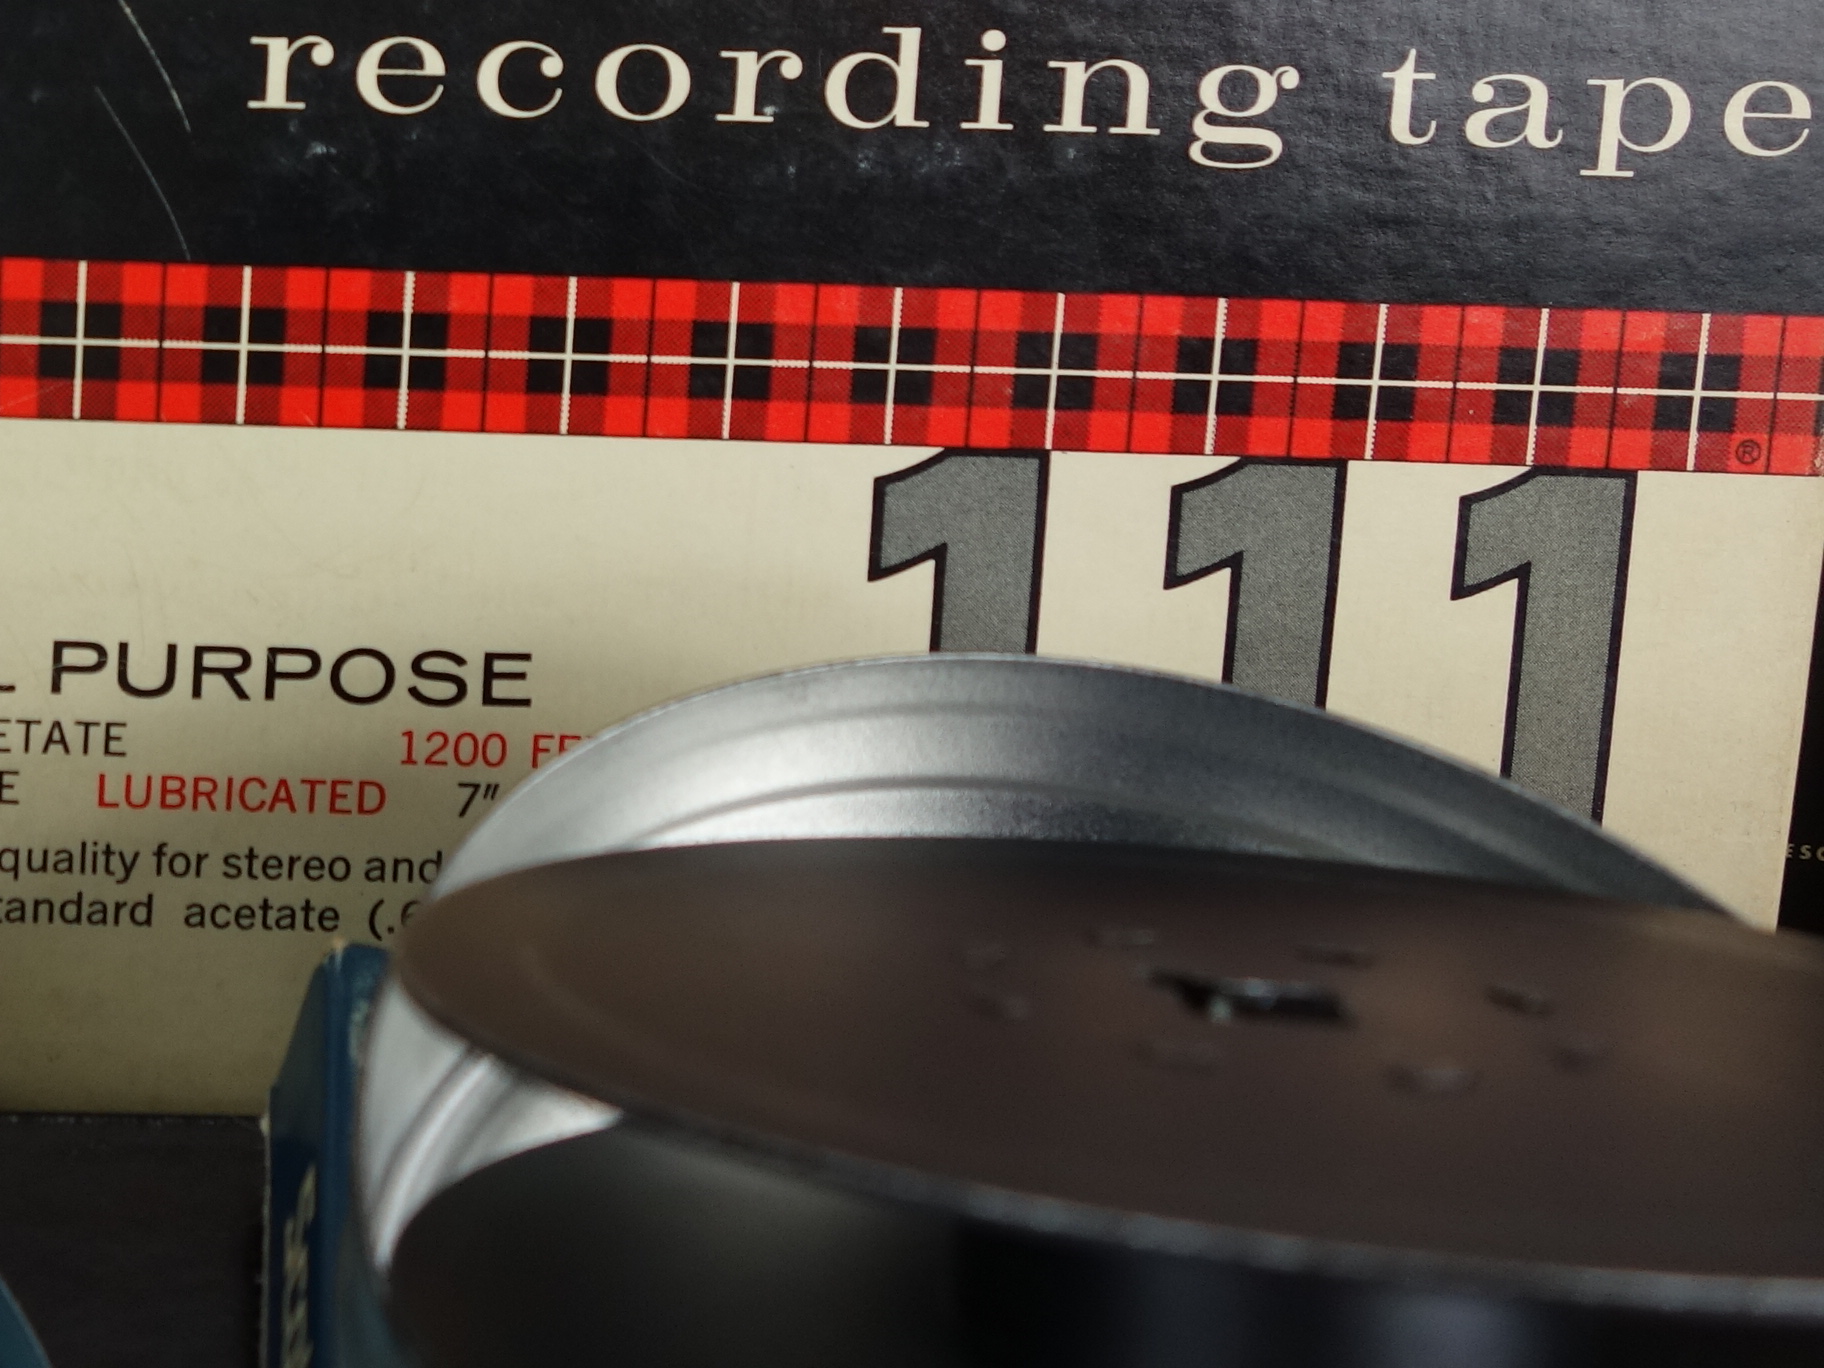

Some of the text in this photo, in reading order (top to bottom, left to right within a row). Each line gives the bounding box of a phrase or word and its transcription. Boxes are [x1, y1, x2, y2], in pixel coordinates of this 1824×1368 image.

[247, 26, 1812, 178] recording tape
[866, 440, 1639, 827] 111
[50, 640, 534, 708] PURPOSE
[401, 730, 508, 768] 1200
[96, 772, 387, 816] LUBRICATED
[152, 842, 209, 878] for
[222, 846, 352, 883] stereo
[363, 850, 443, 884] and
[184, 897, 341, 933] acetate
